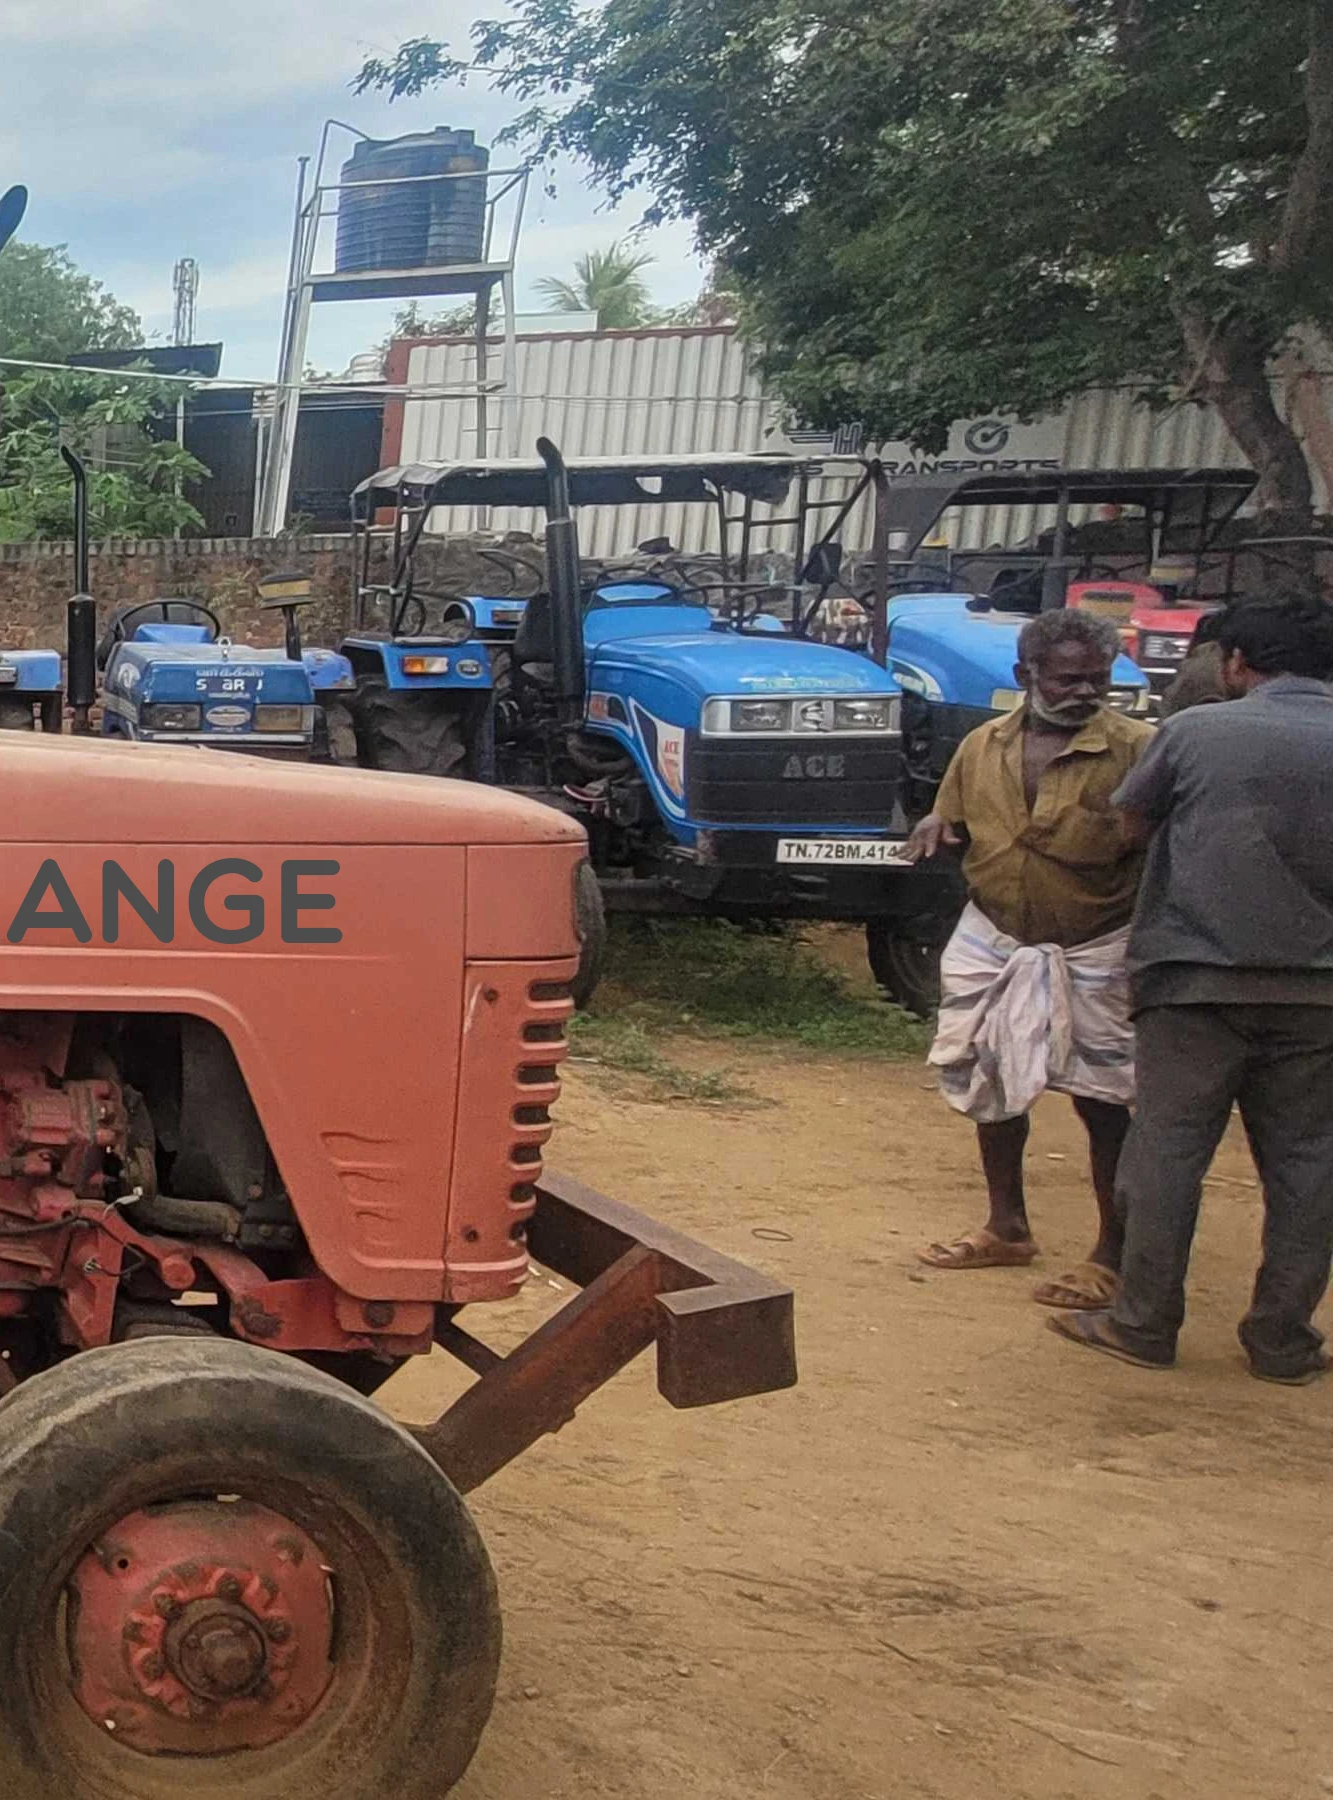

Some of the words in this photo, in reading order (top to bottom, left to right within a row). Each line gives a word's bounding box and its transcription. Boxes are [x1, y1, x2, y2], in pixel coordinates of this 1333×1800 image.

[879, 459, 1062, 476] RANSPORTS
[783, 755, 845, 778] ACE
[785, 843, 900, 859] TN.72BM.414
